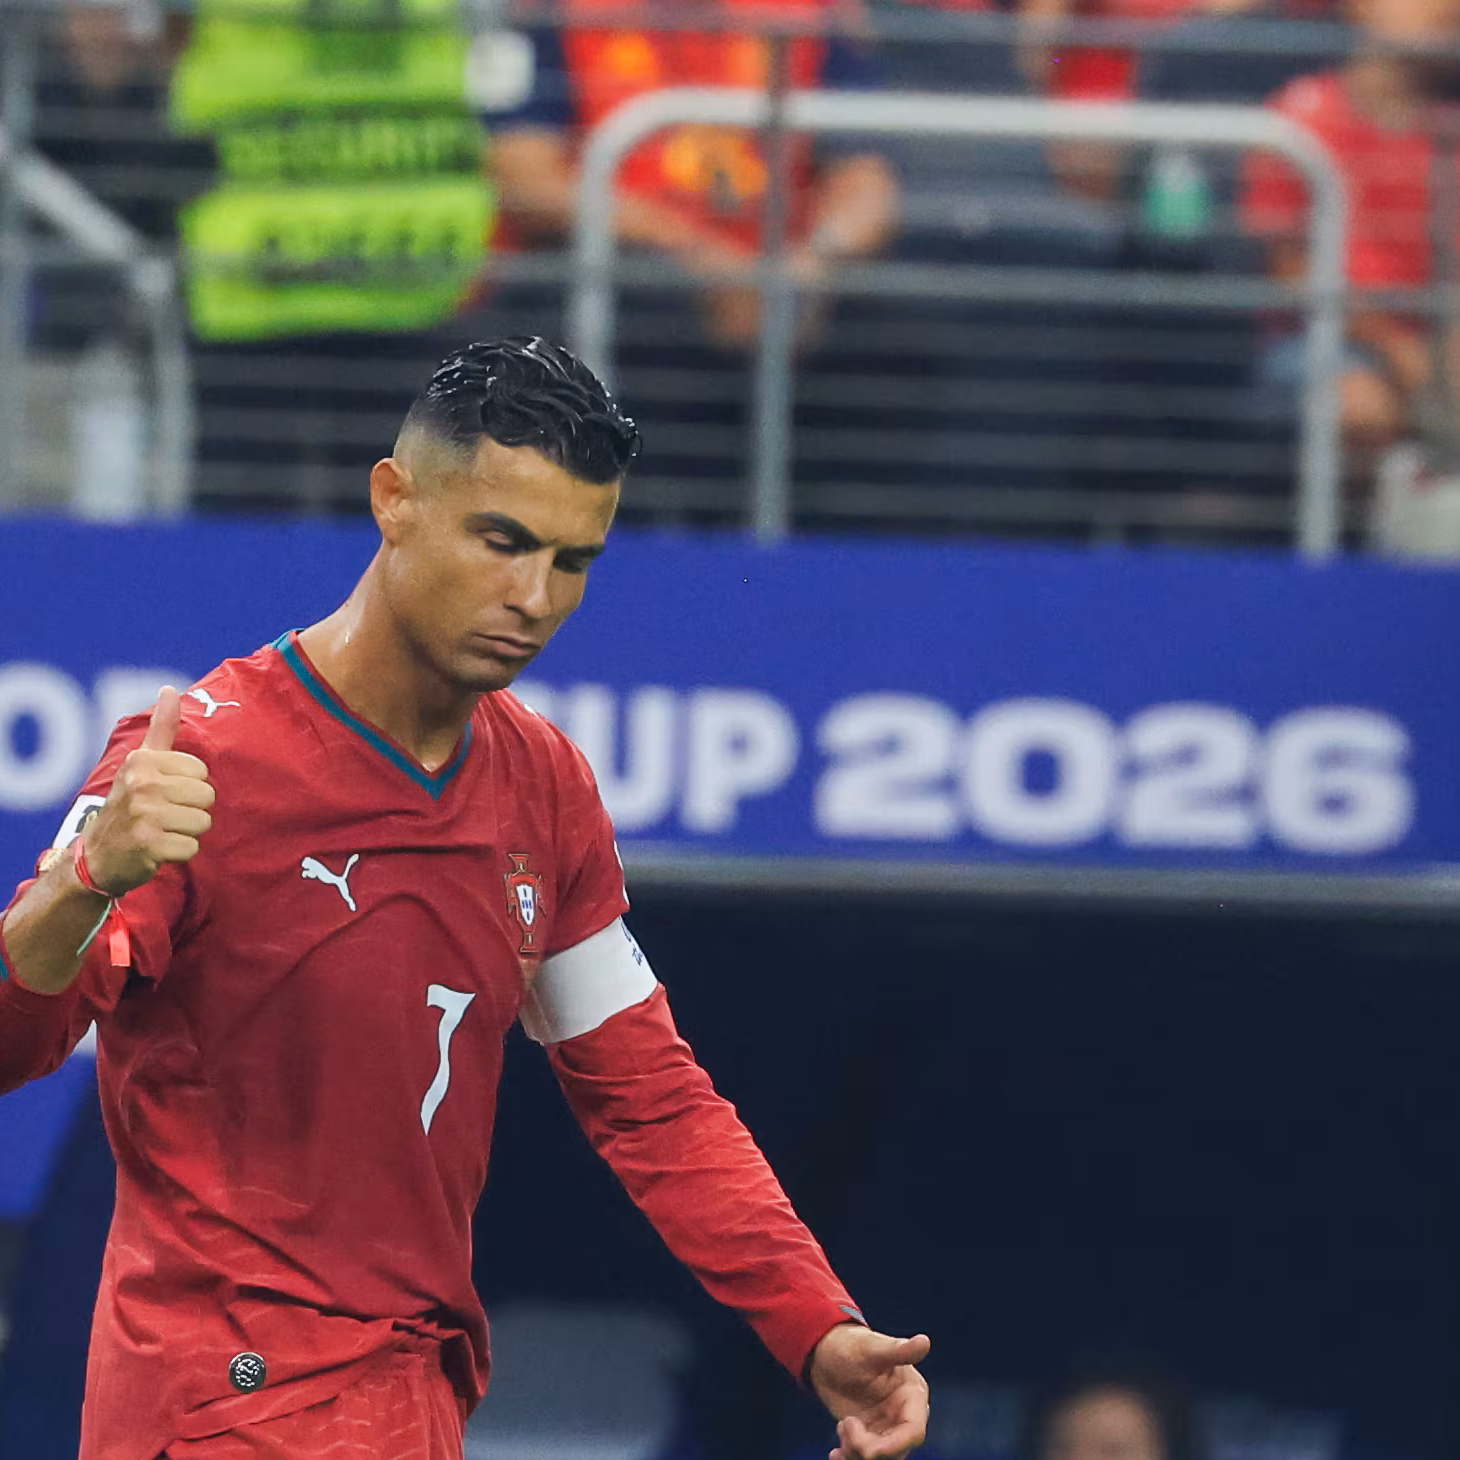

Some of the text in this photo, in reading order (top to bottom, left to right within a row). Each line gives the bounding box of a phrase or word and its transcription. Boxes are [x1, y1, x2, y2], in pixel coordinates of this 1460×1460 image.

[510, 680, 799, 832] UP
[814, 690, 1413, 856] 2026
[420, 984, 477, 1137] 7
